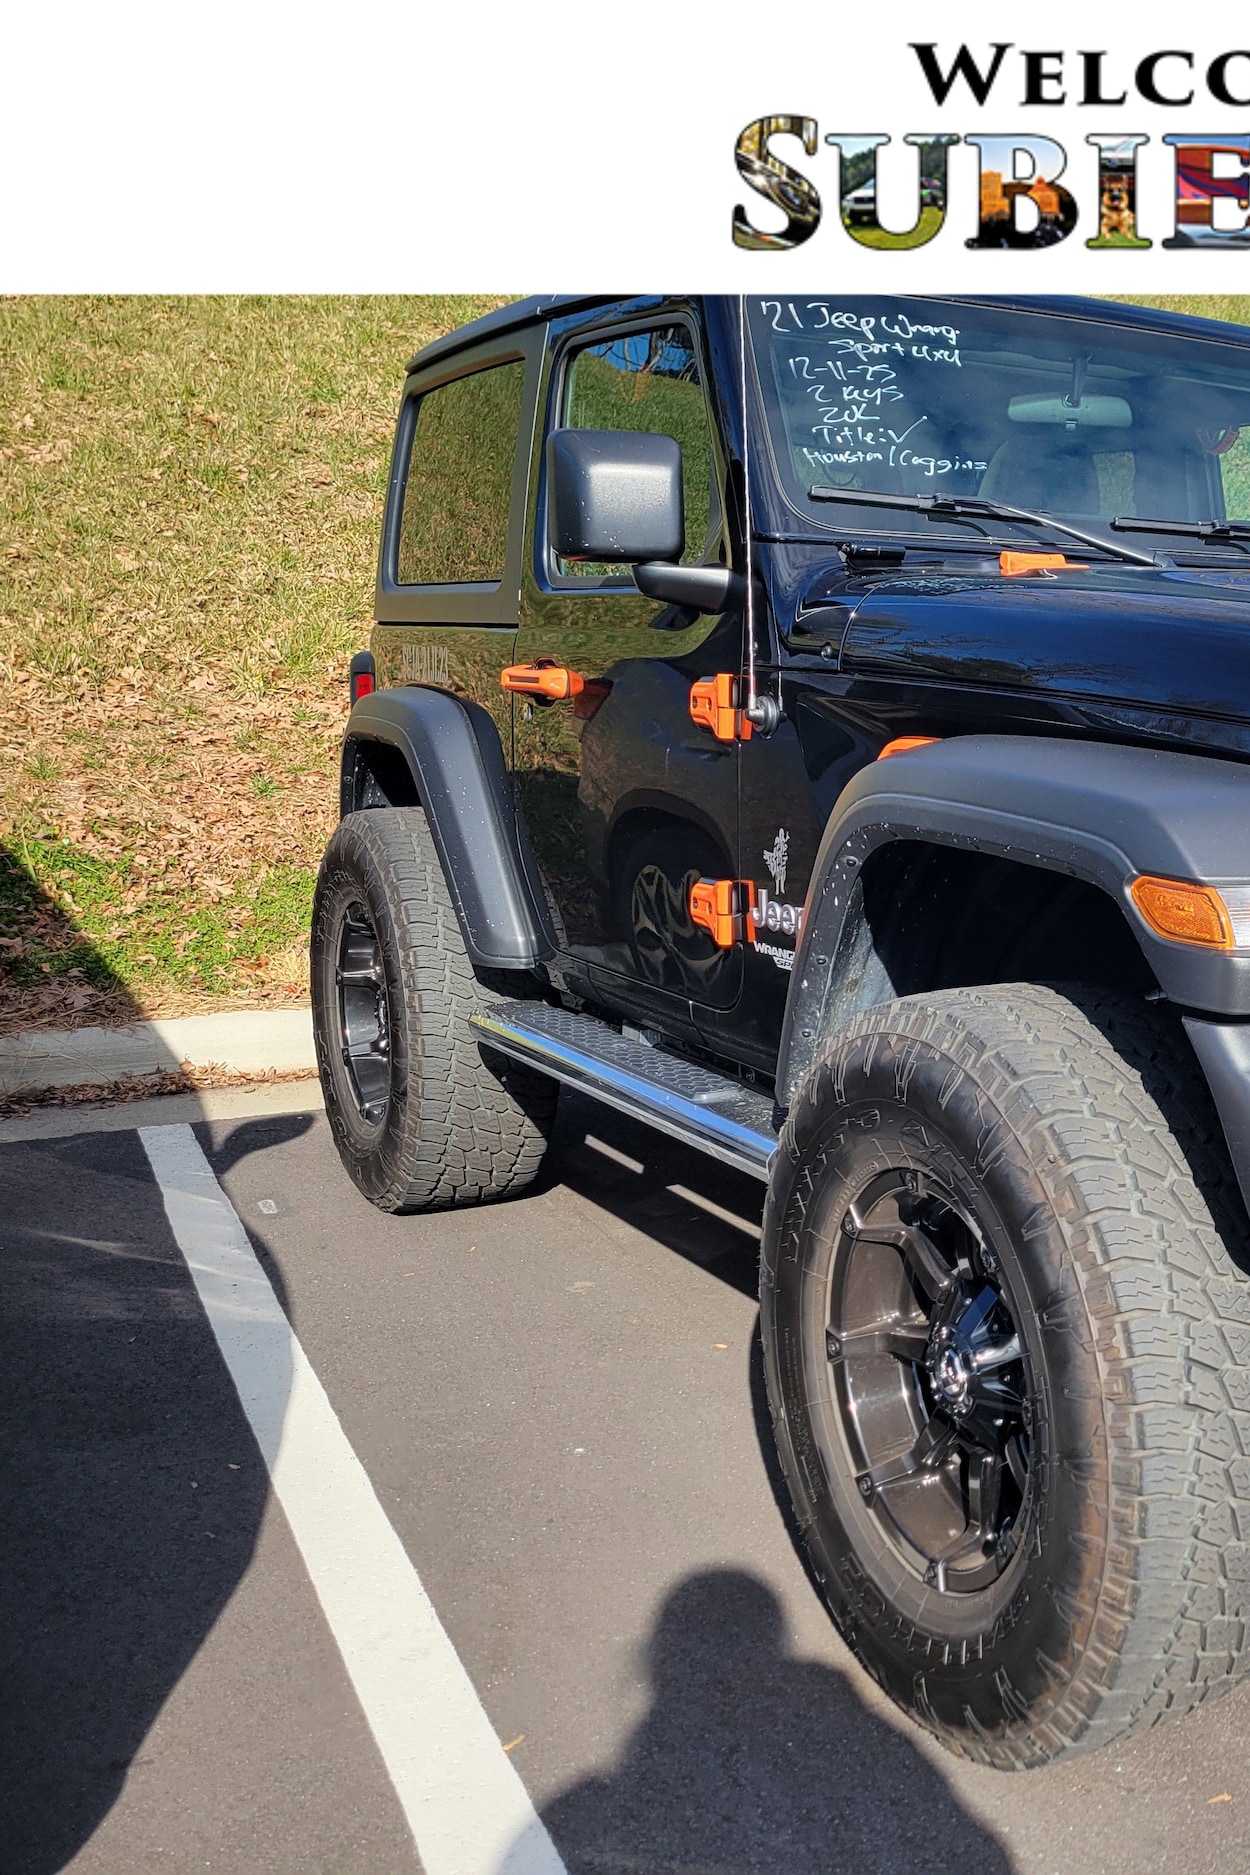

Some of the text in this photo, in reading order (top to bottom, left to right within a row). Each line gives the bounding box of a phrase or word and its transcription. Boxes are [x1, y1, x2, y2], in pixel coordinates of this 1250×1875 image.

[807, 302, 876, 341] Jeep
[828, 339, 904, 363] Sport
[788, 357, 896, 383] 12-11-25
[806, 385, 832, 402] 2
[753, 940, 795, 960] WRANG
